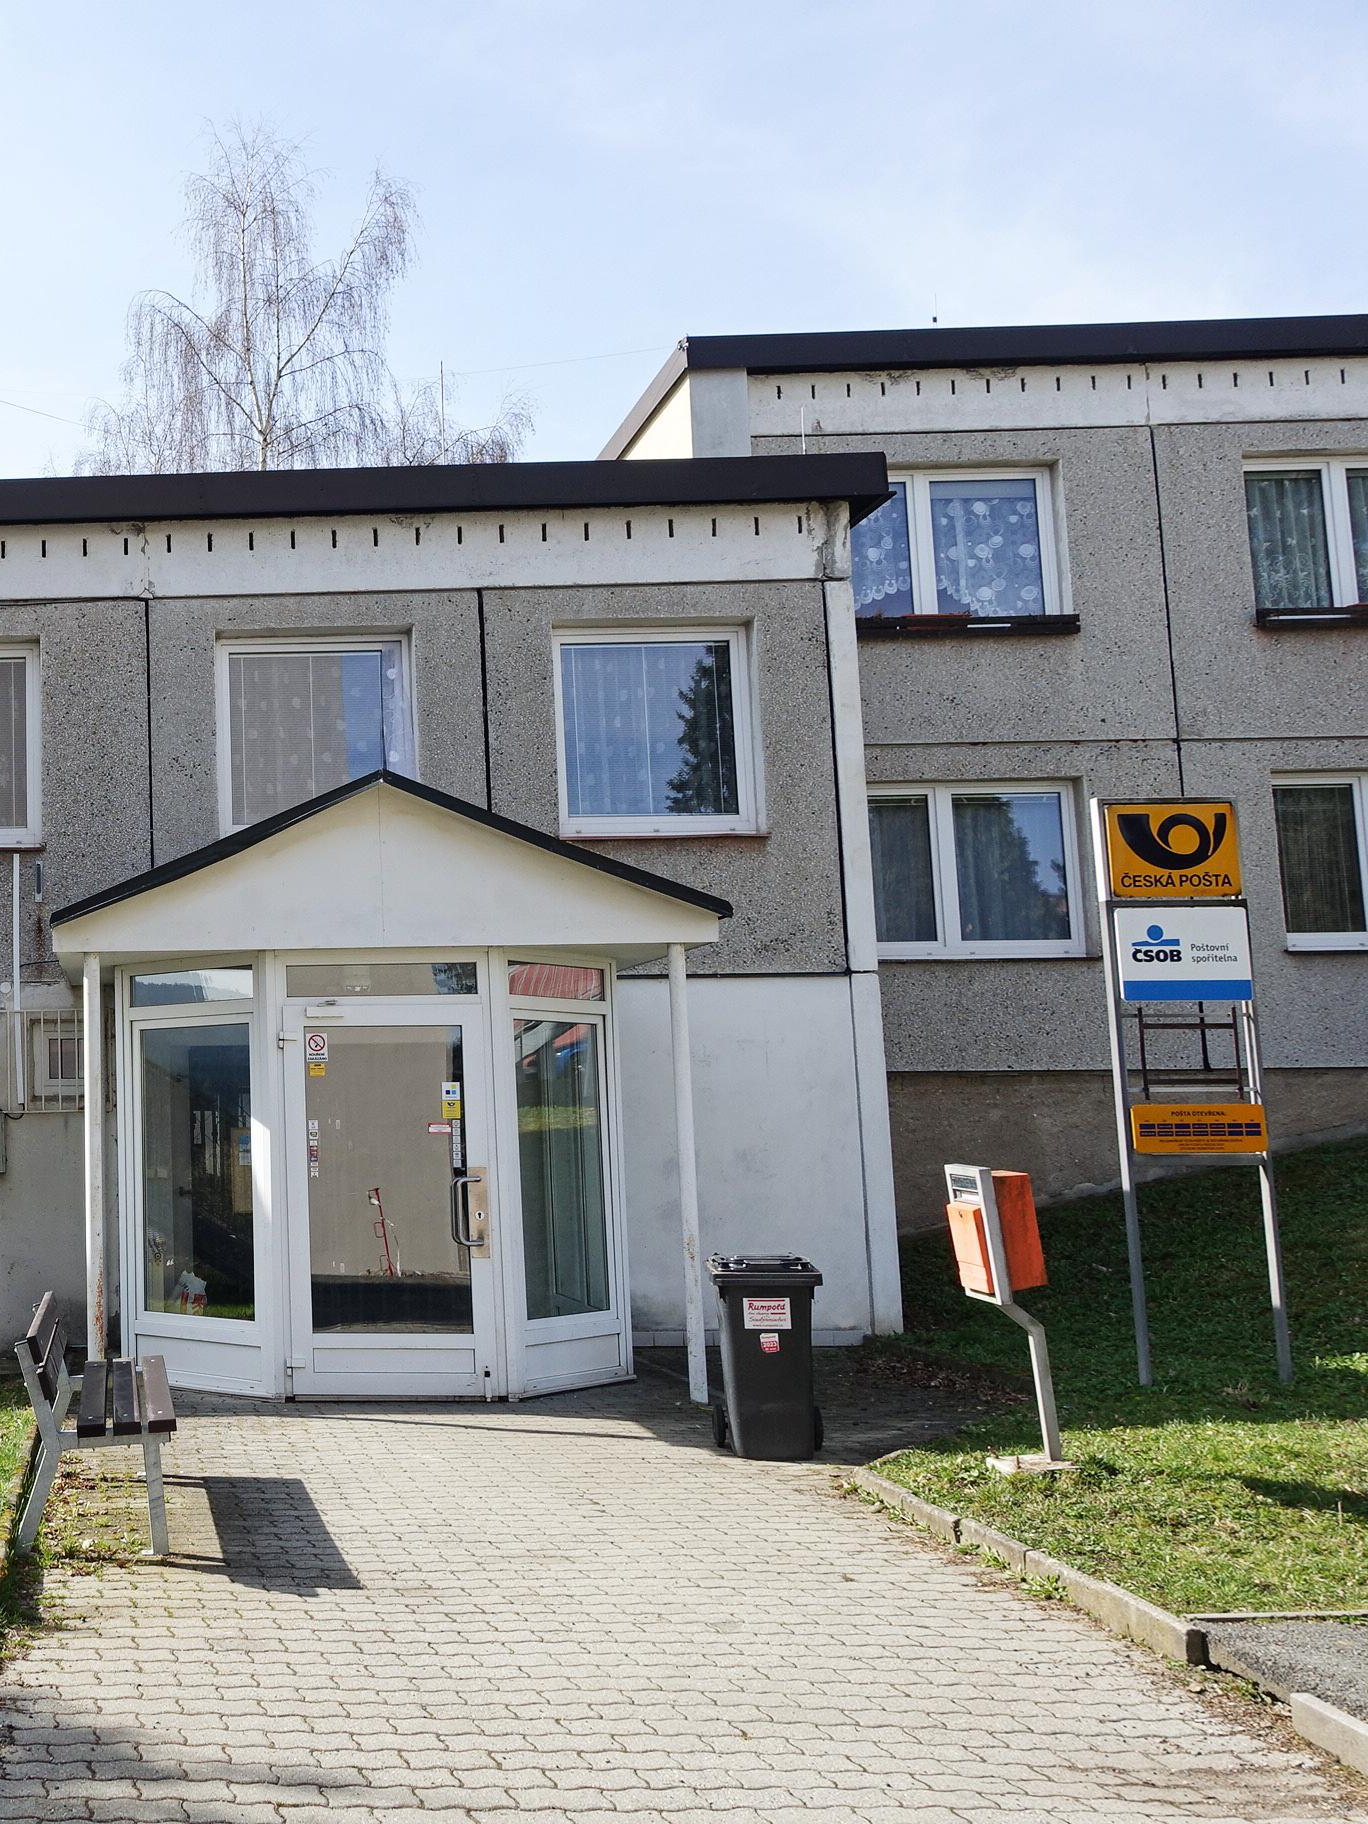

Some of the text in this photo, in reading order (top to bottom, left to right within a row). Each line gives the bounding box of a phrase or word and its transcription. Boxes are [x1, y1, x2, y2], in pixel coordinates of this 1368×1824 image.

[1120, 871, 1233, 888] ČESKÁ POŠTA
[1190, 942, 1230, 952] Poštovní
[1131, 947, 1183, 963] ČSOB
[1191, 953, 1239, 965] spořitelna
[748, 1302, 786, 1311] Rumpold
